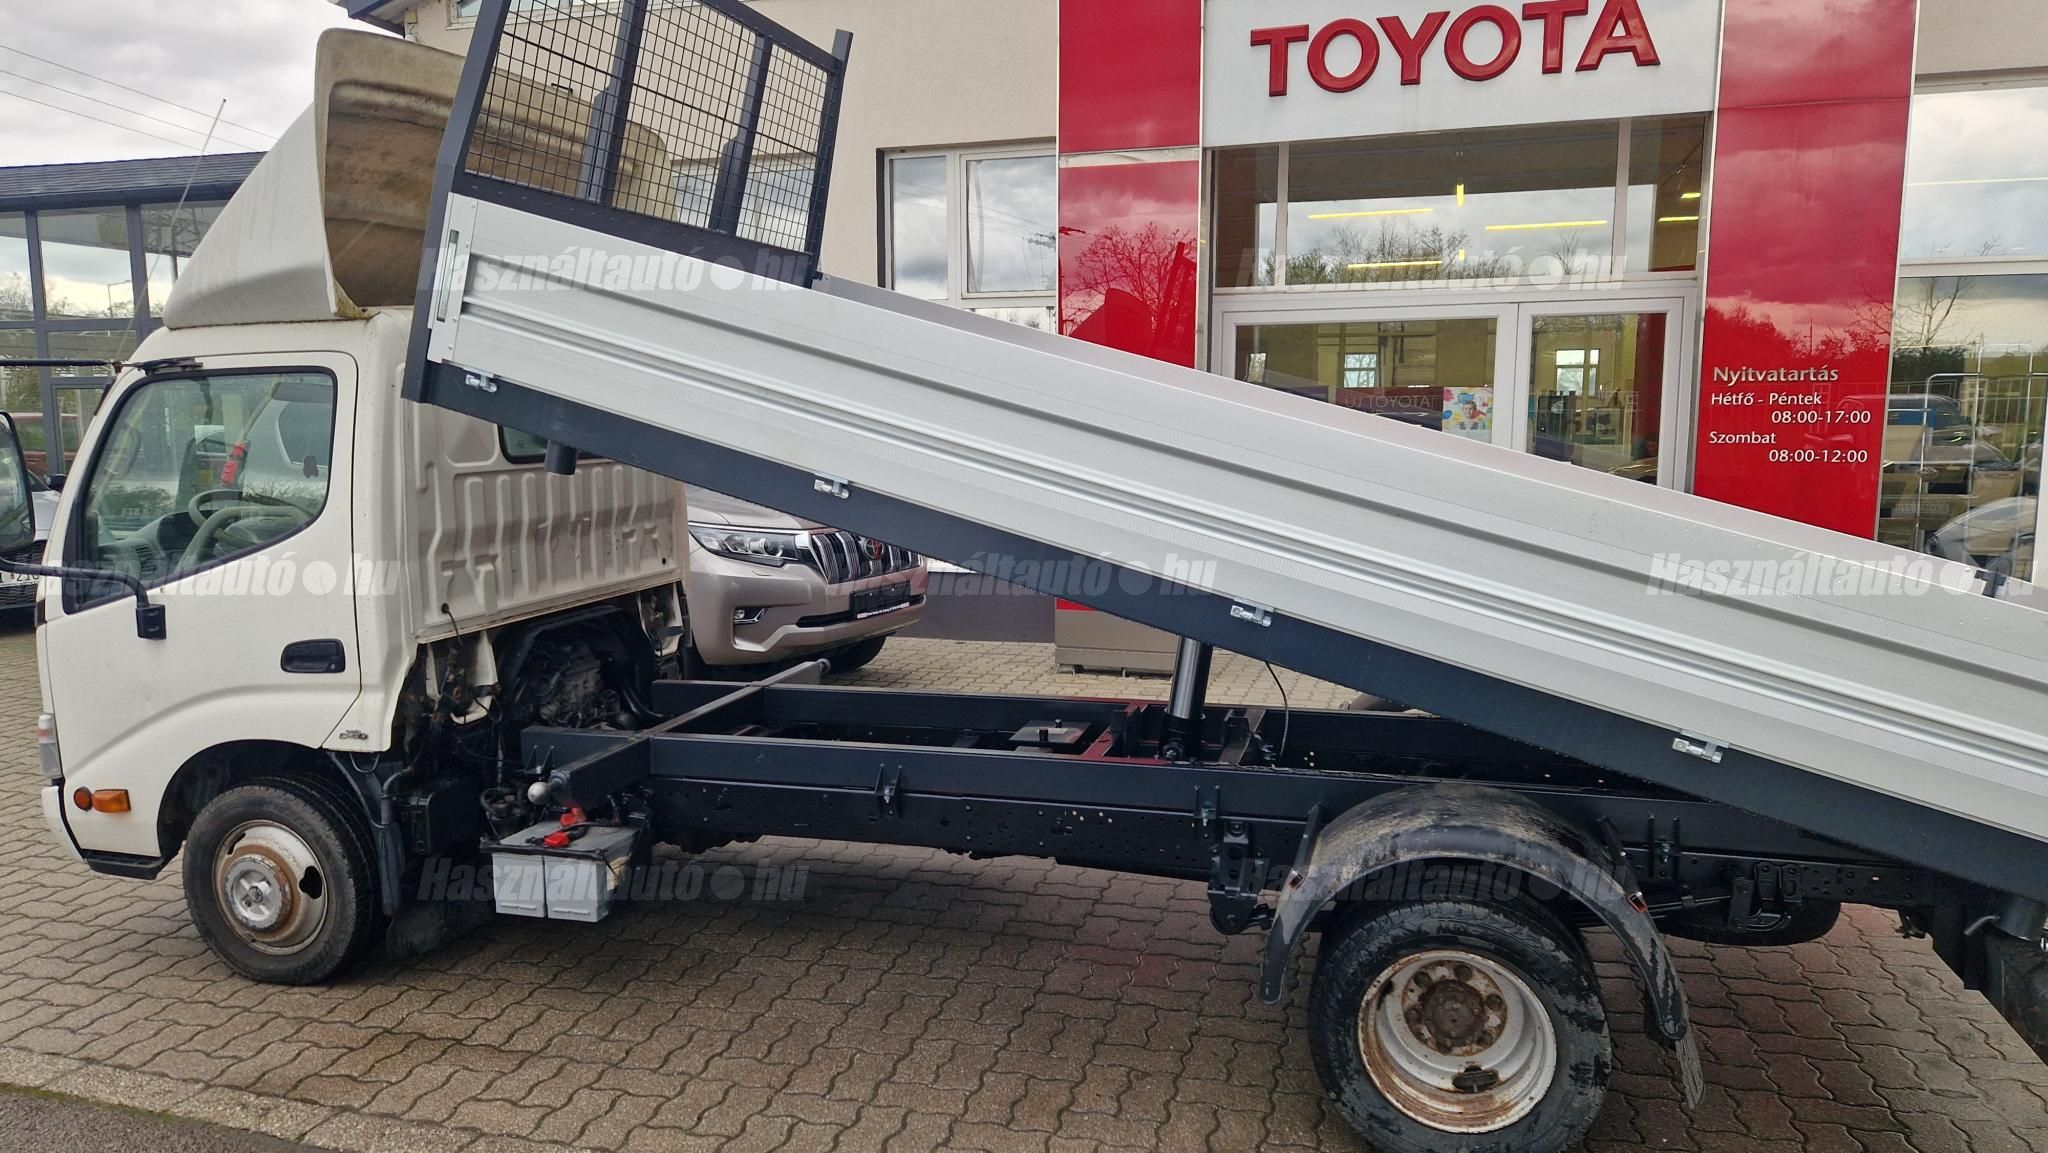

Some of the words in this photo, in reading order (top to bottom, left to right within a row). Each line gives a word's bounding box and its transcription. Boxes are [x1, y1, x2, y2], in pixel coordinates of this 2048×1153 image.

[1250, 0, 1661, 97] TOYOTA
[1713, 365, 1839, 386] Nyitvatartás
[1711, 392, 1754, 406] Hétfő
[1769, 391, 1822, 405] Péntek
[1771, 410, 1871, 424] 08:00-17:00
[1709, 431, 1777, 444] Szombat
[1769, 450, 1868, 463] 08:00-12:00
